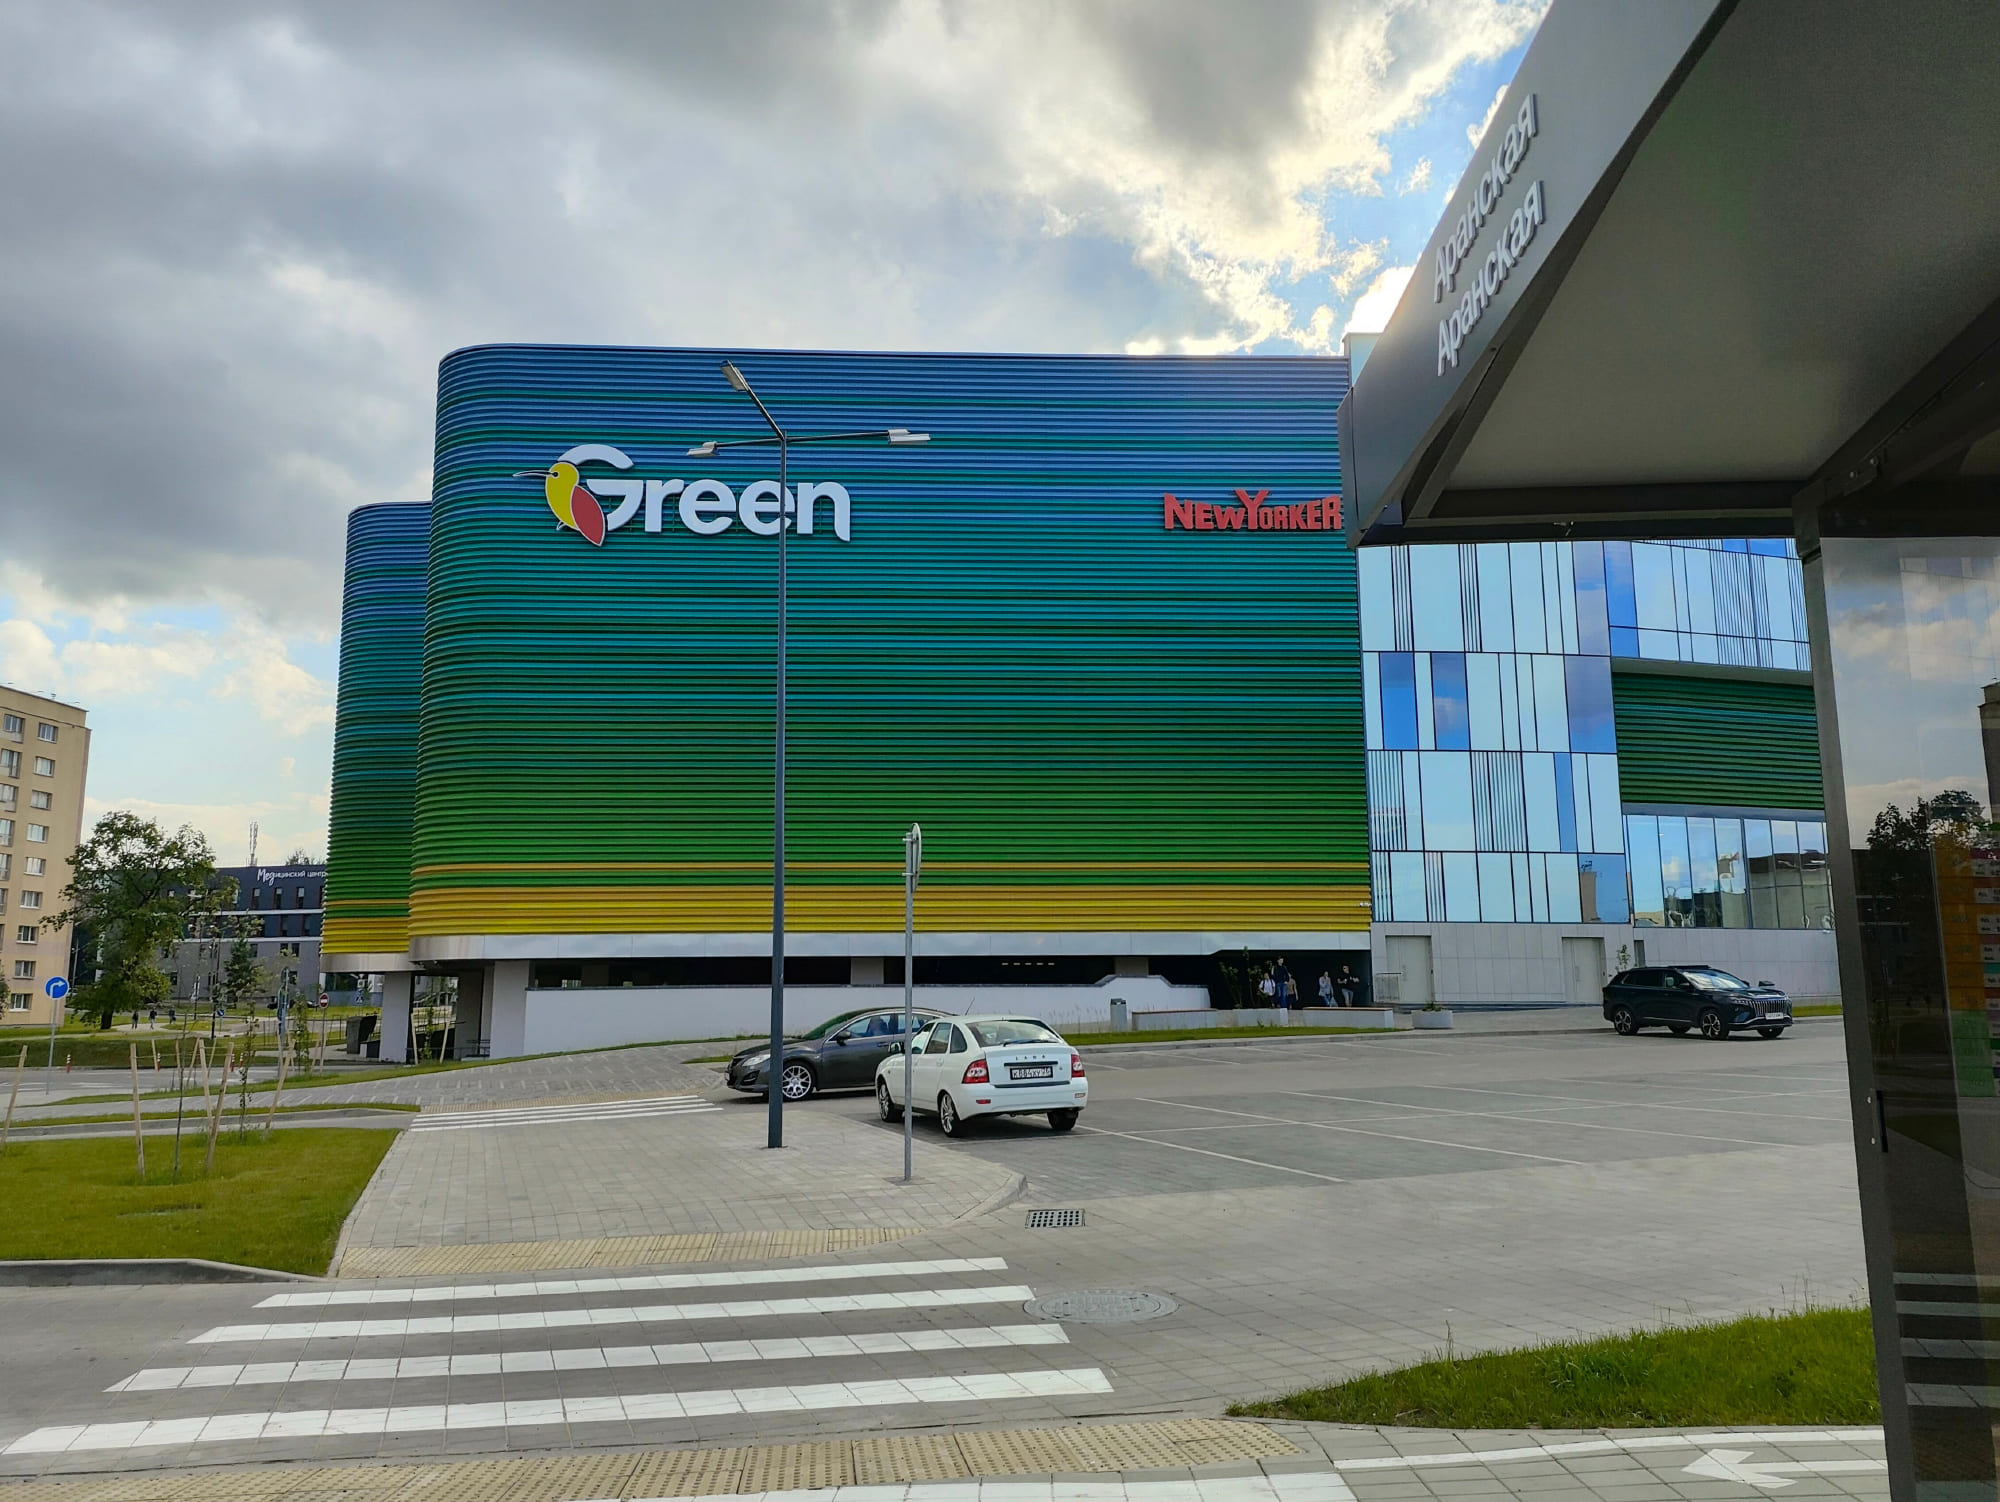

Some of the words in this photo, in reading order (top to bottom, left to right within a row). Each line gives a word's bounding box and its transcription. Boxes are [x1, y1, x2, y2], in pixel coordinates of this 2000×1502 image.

[1433, 92, 1538, 303] Аранская
[1437, 180, 1545, 377] Аранская
[557, 443, 851, 542] Green
[257, 868, 306, 887] Медицинский
